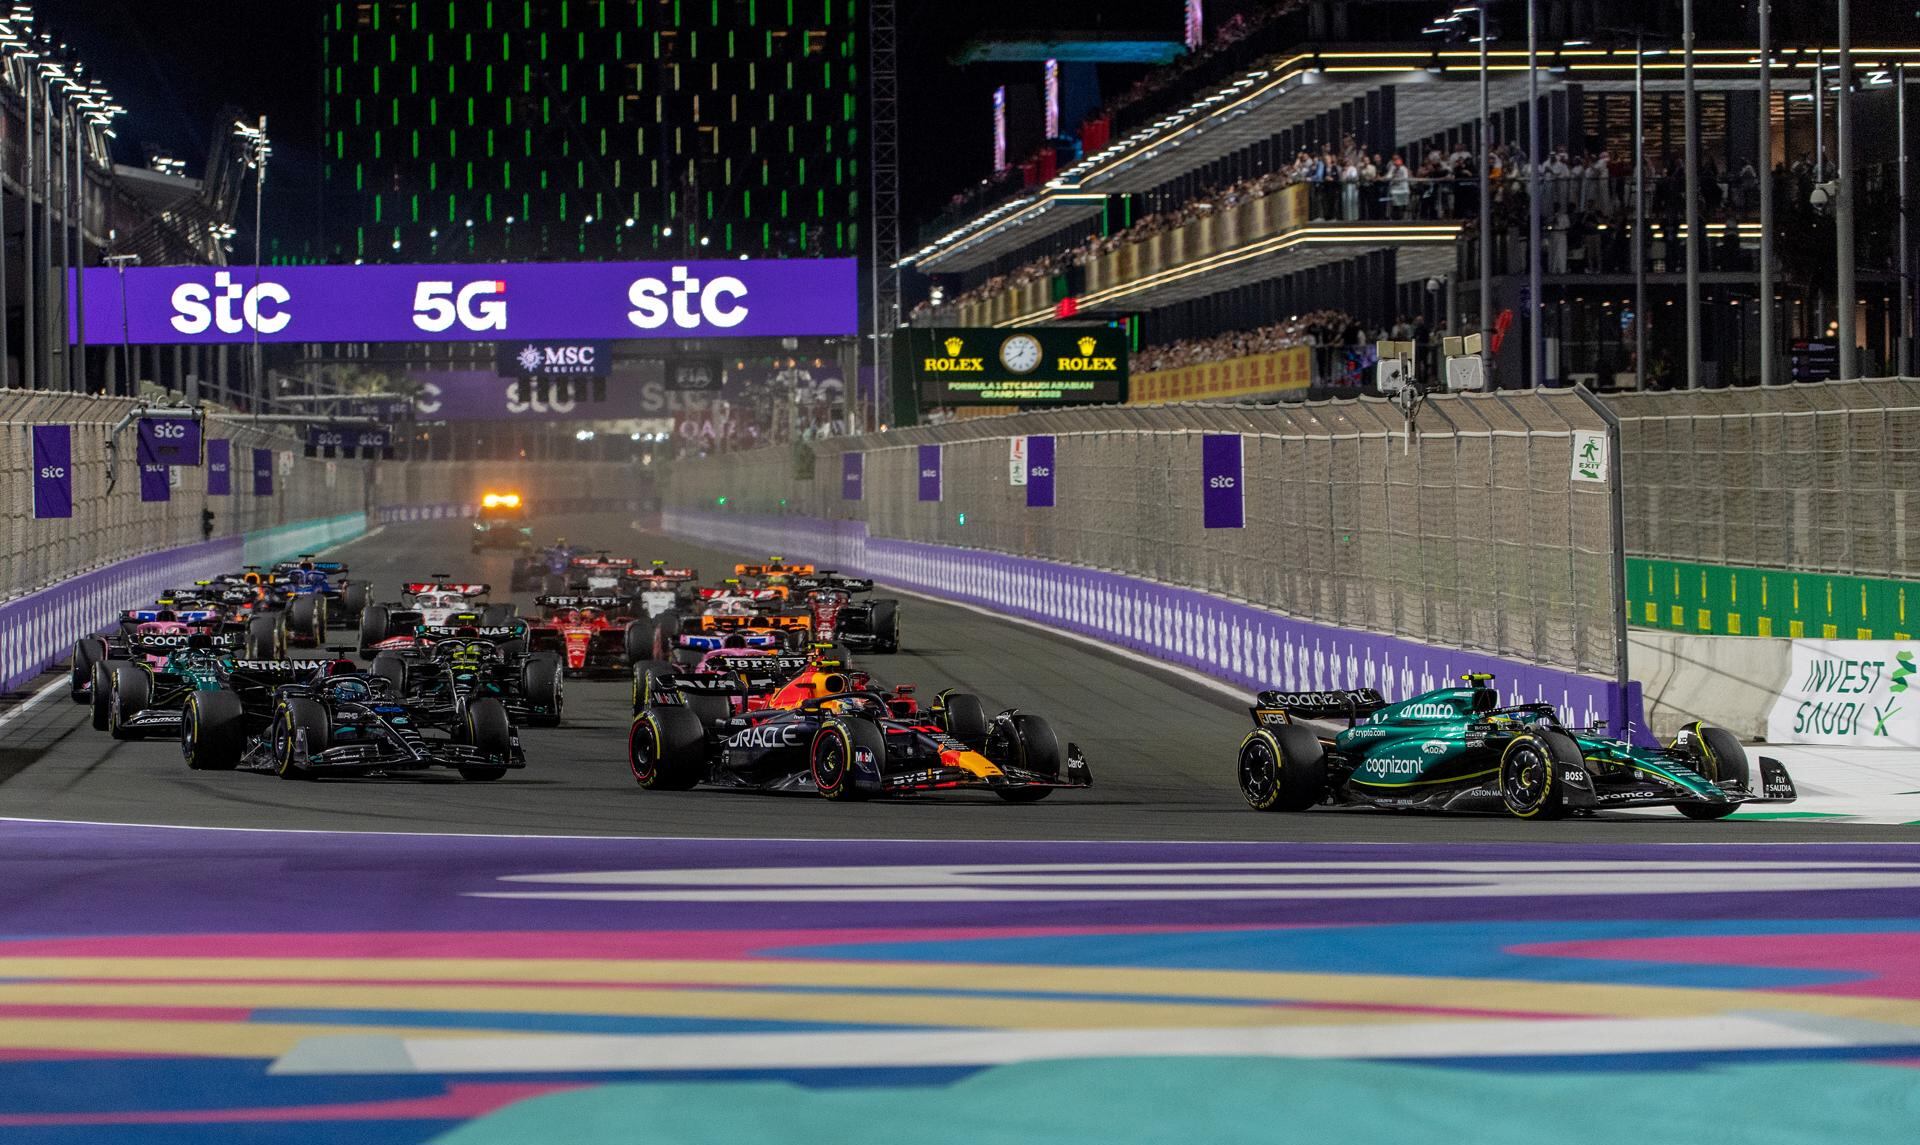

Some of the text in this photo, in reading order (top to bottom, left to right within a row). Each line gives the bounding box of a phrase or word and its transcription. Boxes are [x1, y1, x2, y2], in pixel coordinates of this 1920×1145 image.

[170, 271, 291, 334] stc
[628, 266, 749, 328] stc
[412, 280, 507, 332] 5G
[544, 347, 594, 365] MSC
[924, 358, 984, 371] ROLEX
[1057, 358, 1117, 371] ROLEX
[154, 422, 185, 439] stc
[41, 465, 65, 479] stc
[1031, 466, 1049, 477] stc
[1579, 462, 1600, 470] EXIT
[1210, 474, 1235, 489] stc
[430, 626, 511, 636] PETNAS
[143, 632, 233, 647] cognnt
[1802, 659, 1885, 694] INVEST
[1275, 689, 1376, 708] cogniznt
[1400, 703, 1455, 719] aramco
[1794, 701, 1865, 735] SAUDI
[1262, 713, 1286, 725] JCB
[728, 724, 806, 748] ORACLE
[1355, 729, 1386, 741] crypto.com
[1365, 755, 1424, 779] cognizant
[1565, 771, 1584, 781] BOSS
[1775, 776, 1786, 784] FLY
[1470, 789, 1491, 797] ASTON
[1769, 784, 1792, 793] SAUDIA
[1597, 791, 1655, 801] aramco
